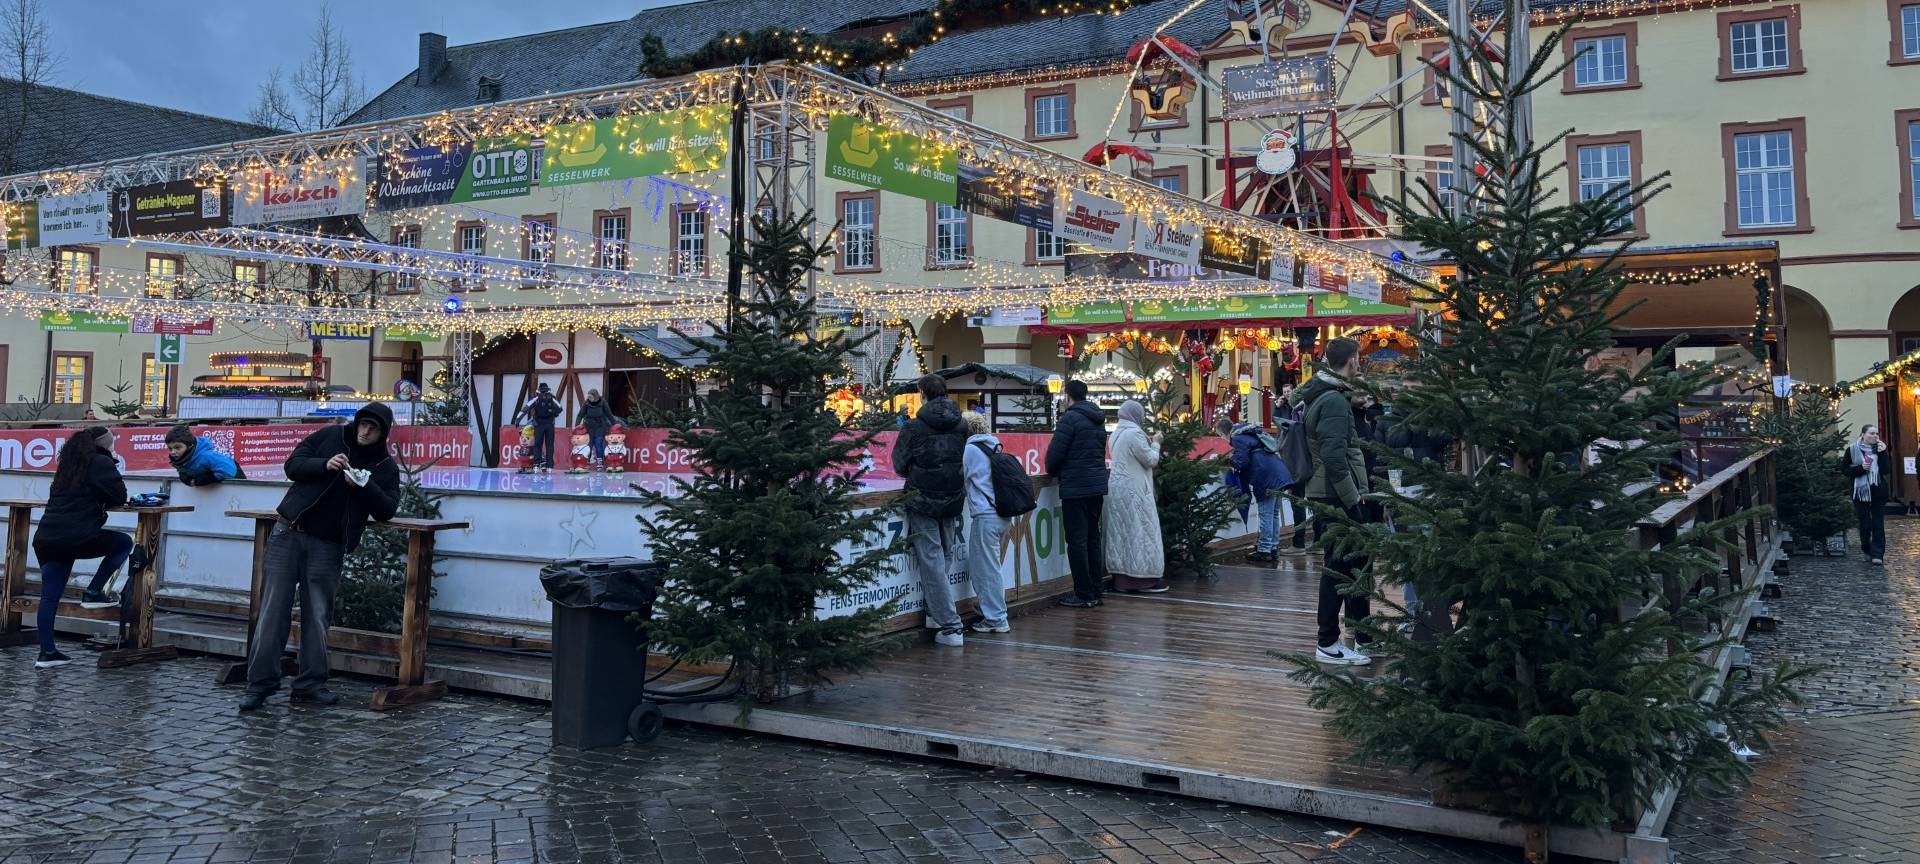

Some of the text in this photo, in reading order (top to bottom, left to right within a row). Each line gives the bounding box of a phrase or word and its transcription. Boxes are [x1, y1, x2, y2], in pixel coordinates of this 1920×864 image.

[1232, 84, 1324, 101] Weihnachtsmarkt
[646, 138, 666, 153] will
[400, 164, 432, 181] schöne
[472, 149, 528, 179] OTTO
[893, 157, 904, 171] So
[921, 165, 931, 177] ich
[933, 170, 955, 184] sitzen
[472, 177, 506, 187] GARTENBAU
[548, 167, 611, 183] SESSELWERK
[832, 165, 882, 185] SESSELWERK
[379, 178, 455, 198] Weihnachtszeit
[85, 202, 105, 215] Siegtal
[136, 193, 196, 211] Getränke-Wagener
[64, 221, 73, 230] ich
[1066, 205, 1120, 235] Steiner
[1167, 227, 1193, 247] Steiner
[310, 321, 371, 337] METRO
[130, 434, 151, 442] JETZT
[428, 438, 469, 459] mehr
[830, 583, 911, 611] FENSTERMONTAGE
